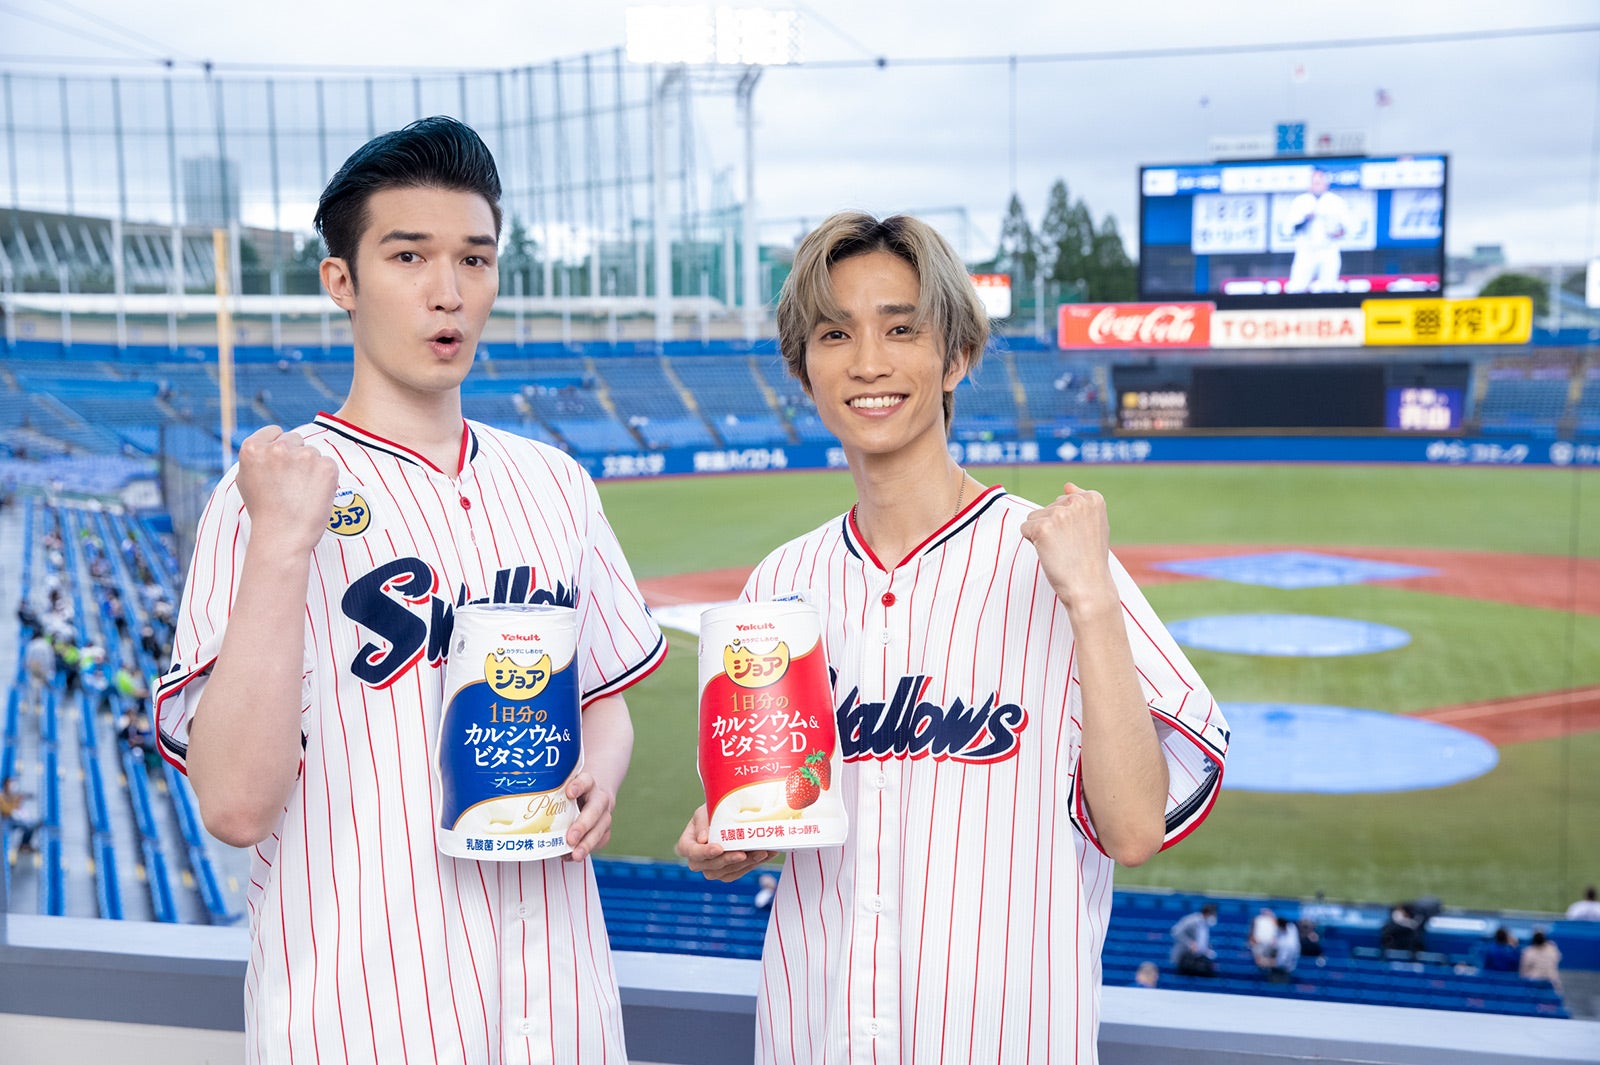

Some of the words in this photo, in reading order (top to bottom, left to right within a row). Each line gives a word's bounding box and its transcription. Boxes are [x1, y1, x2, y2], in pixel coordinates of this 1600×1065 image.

[1222, 318, 1355, 341] TOSHIBA
[1375, 306, 1519, 336] 一番搾り
[501, 633, 541, 642] Yakult
[735, 622, 775, 632] Yakult
[733, 656, 783, 679] ジョア
[495, 669, 545, 690] ジョア
[489, 702, 548, 723] 1日分の
[731, 692, 789, 713] 1日分の
[721, 731, 808, 758] ビタミンD
[474, 746, 560, 769] ビタミンD
[734, 762, 792, 777] ストロベリー
[494, 777, 537, 788] プレーン
[523, 795, 567, 820] Plain
[720, 828, 745, 841] 乳酸菌
[747, 826, 785, 838] シロタ株
[788, 825, 820, 835] はっ酵乳
[466, 838, 494, 851] 乳酸菌
[496, 838, 534, 851] シロタ株
[537, 837, 565, 848] はっ酵乳
